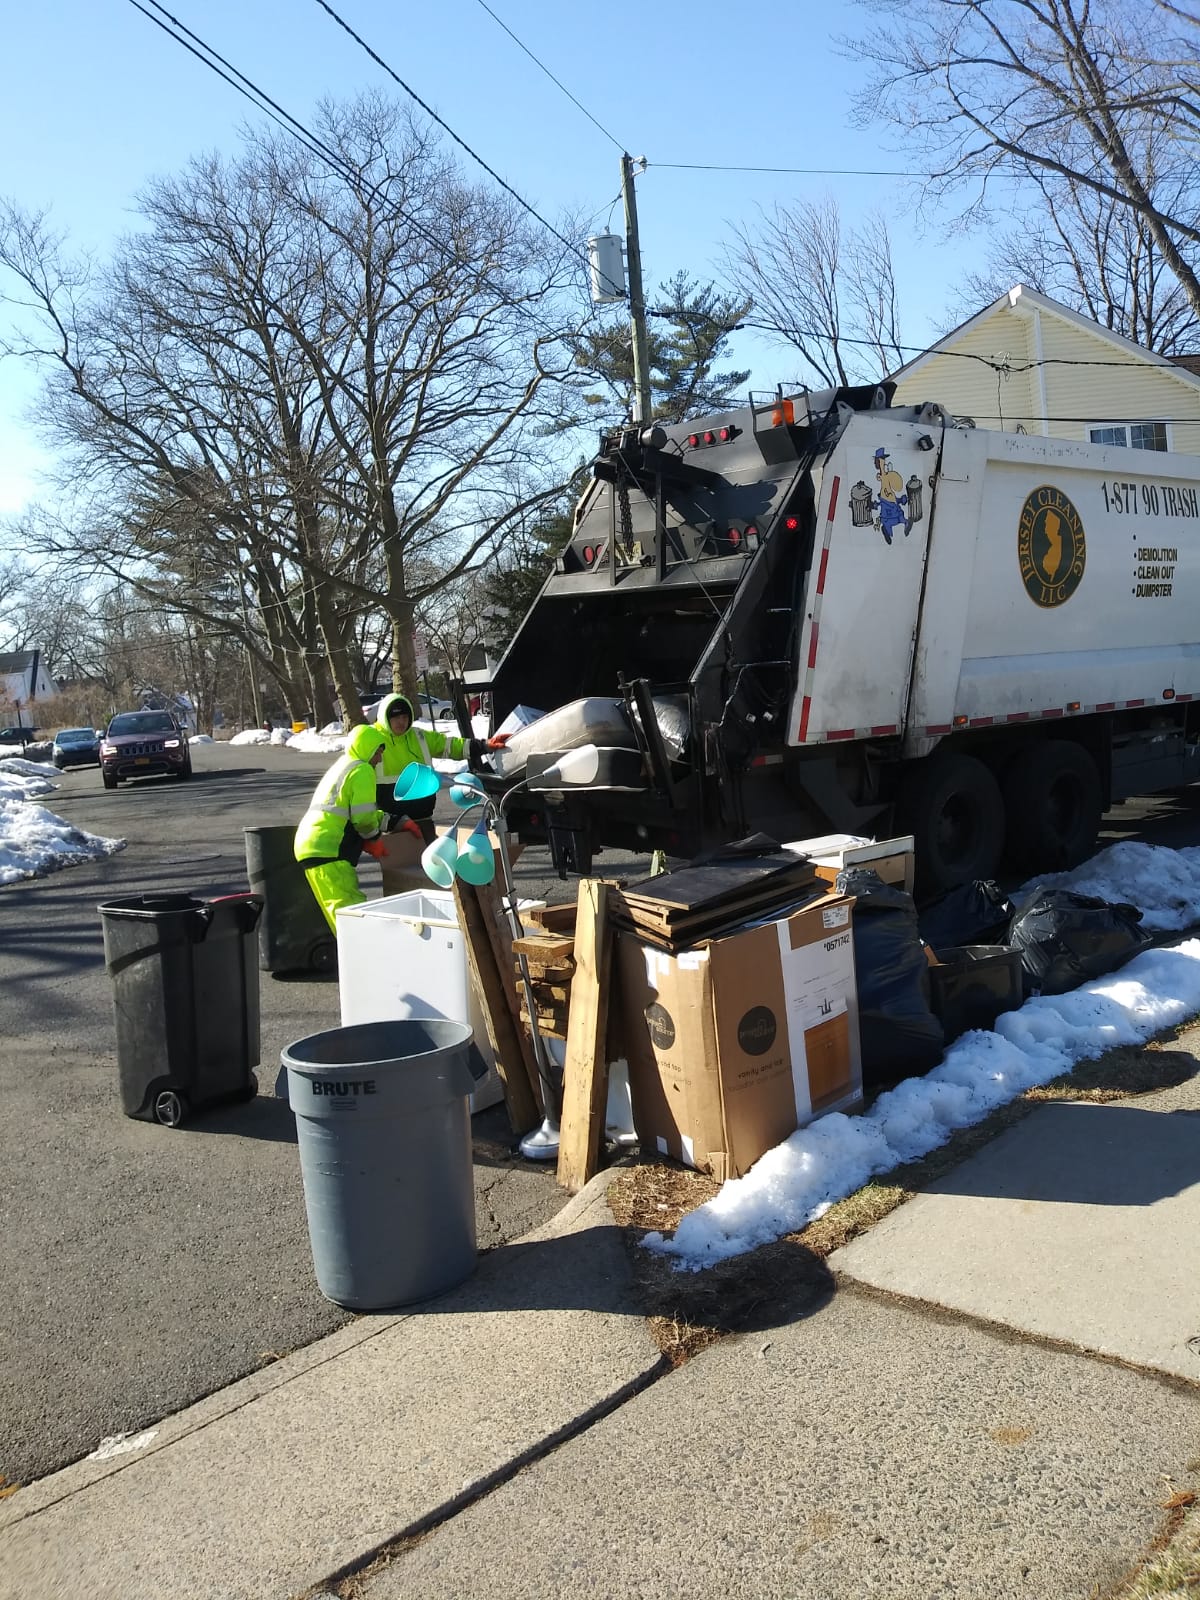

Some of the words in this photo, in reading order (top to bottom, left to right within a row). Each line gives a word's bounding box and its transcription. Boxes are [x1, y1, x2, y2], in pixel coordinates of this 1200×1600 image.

[1101, 481, 1138, 514] 1-877
[1142, 484, 1159, 516] 90
[1160, 486, 1199, 518] TRASH
[1020, 499, 1037, 584] JERSEY
[1038, 489, 1085, 577] CLEANING
[1138, 548, 1178, 562] DEMOLITION
[1137, 566, 1160, 580] CLEAN
[1161, 566, 1175, 580] OUT
[1040, 584, 1066, 604] LLC
[1136, 584, 1173, 598] DUMPSTER
[312, 1080, 377, 1097] BRUTE
